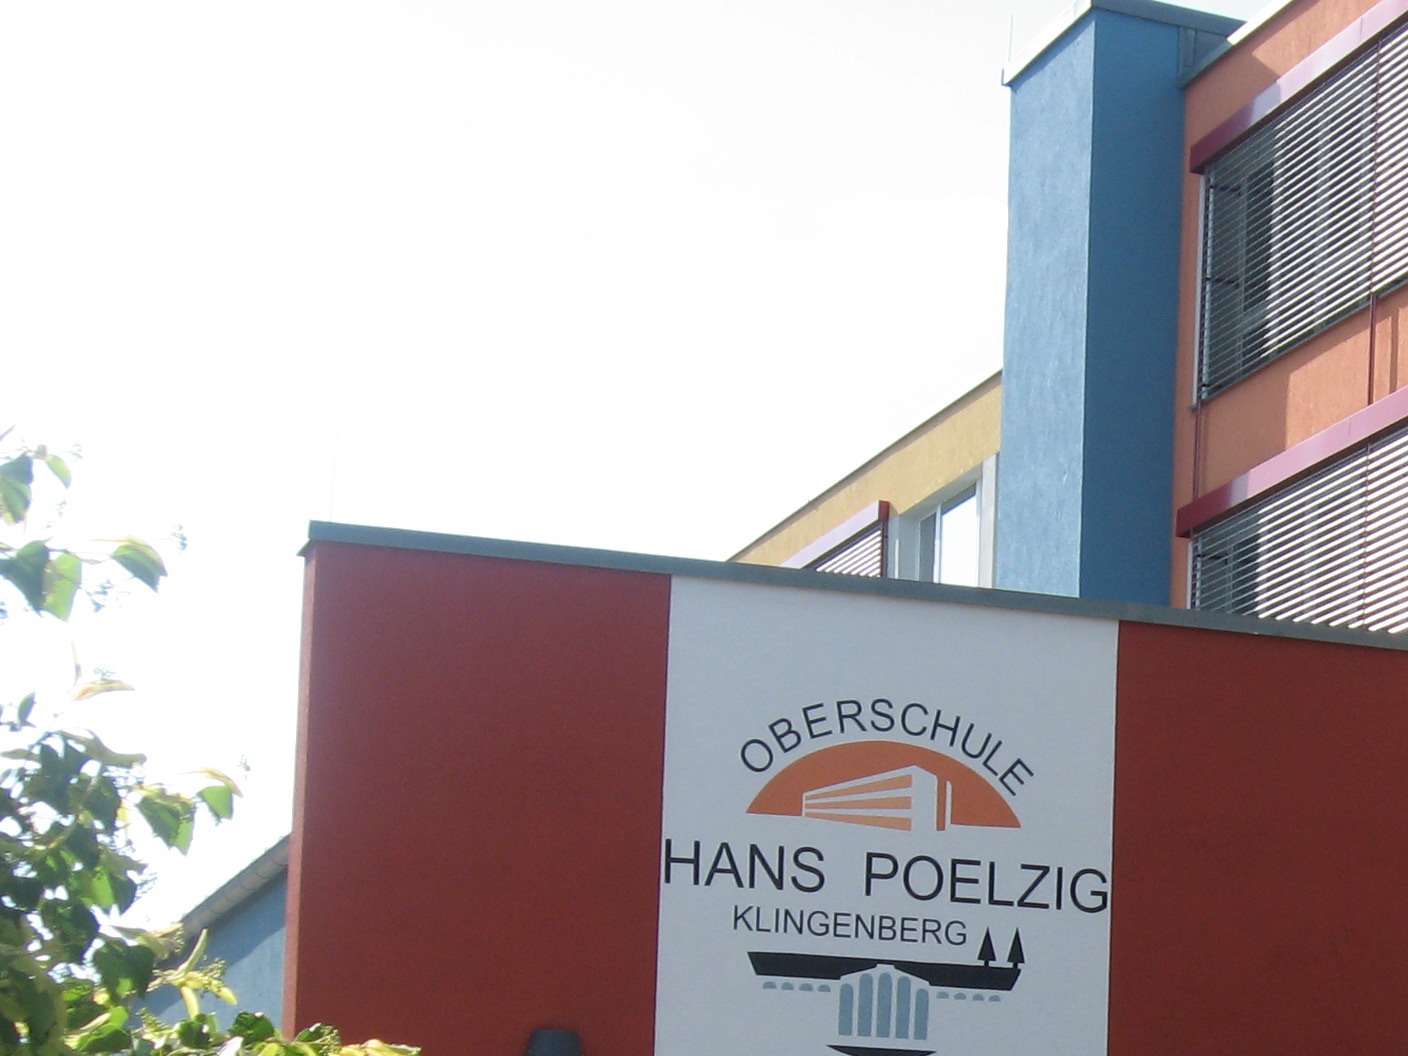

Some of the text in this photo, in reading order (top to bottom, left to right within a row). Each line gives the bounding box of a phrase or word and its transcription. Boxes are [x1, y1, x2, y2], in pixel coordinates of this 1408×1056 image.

[740, 698, 1035, 796] OBERSCHULE
[663, 838, 1108, 913] HANS POELZIG
[732, 904, 967, 945] KLINGENBERG
